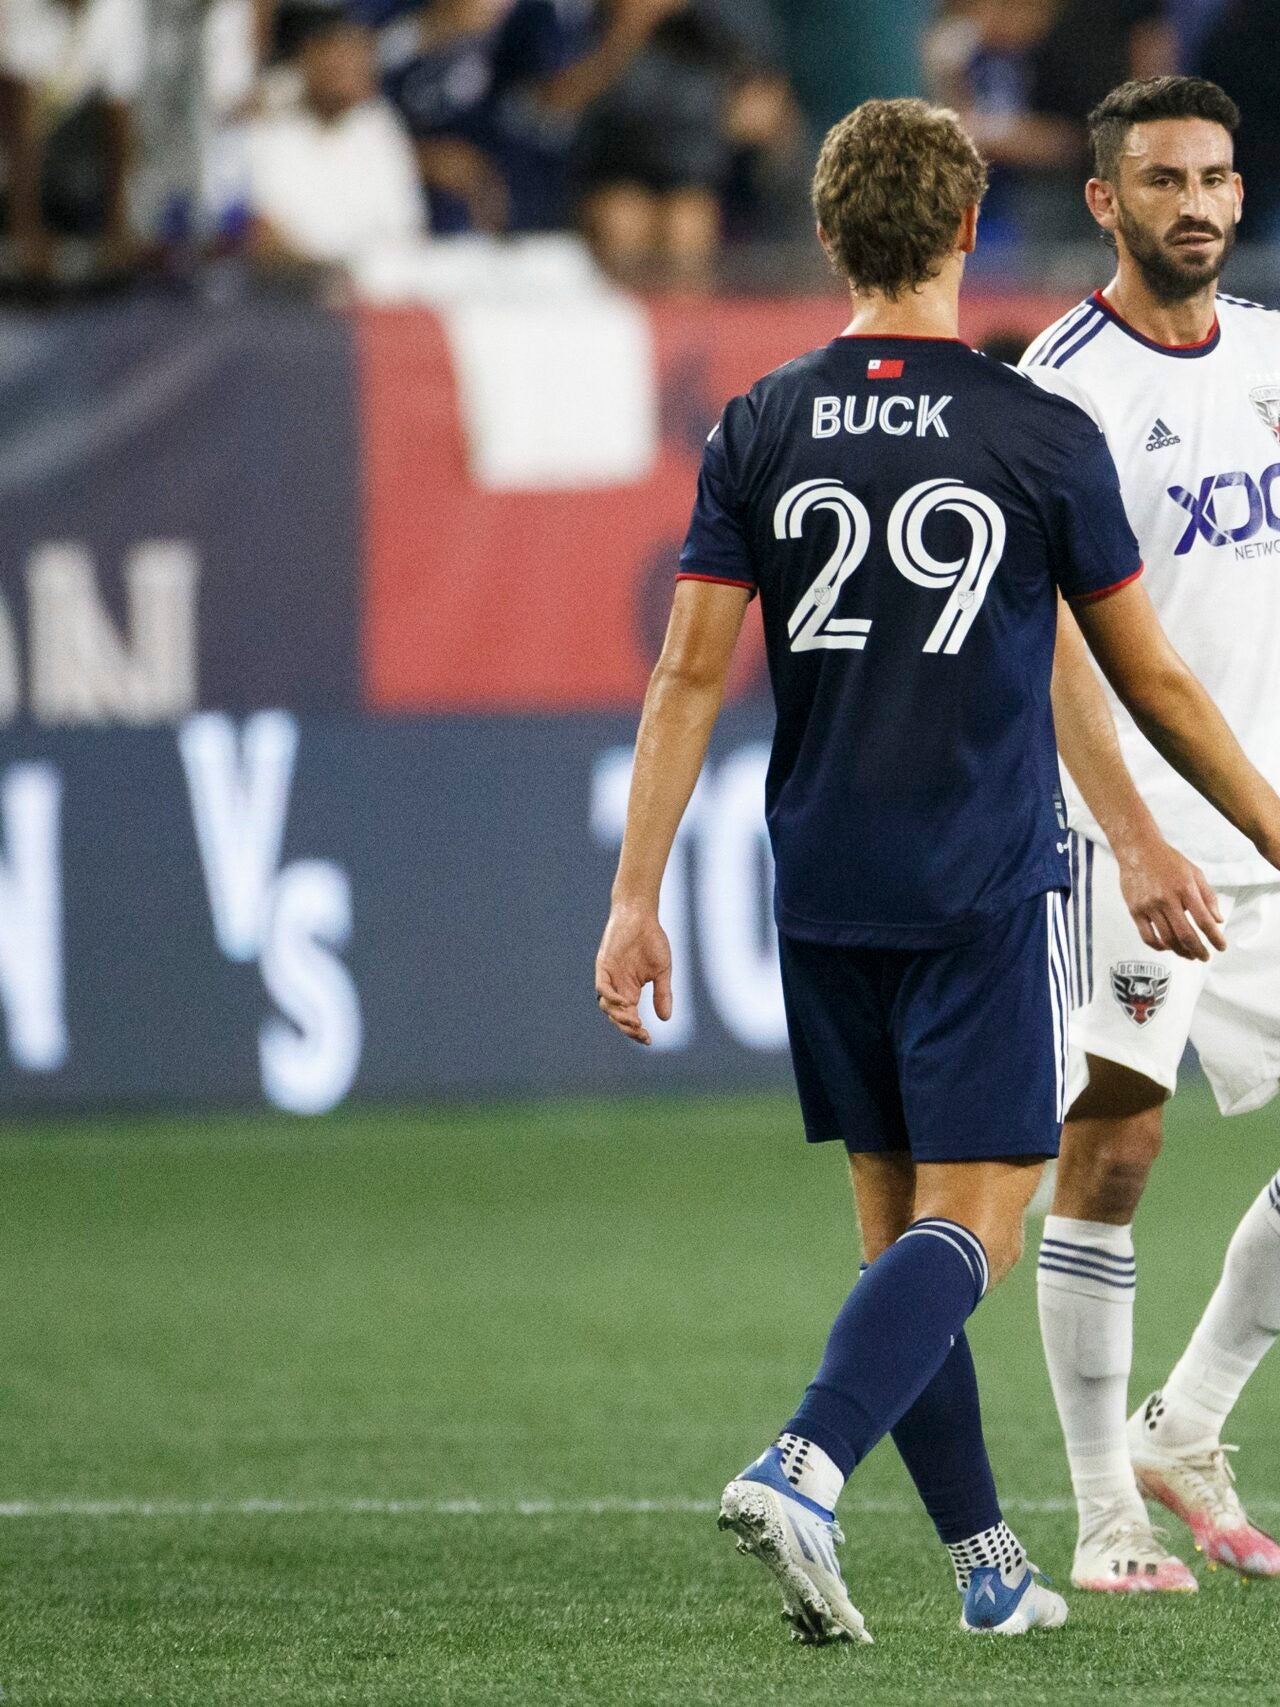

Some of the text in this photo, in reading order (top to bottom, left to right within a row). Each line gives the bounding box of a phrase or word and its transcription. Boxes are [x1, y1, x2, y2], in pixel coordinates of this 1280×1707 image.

[811, 394, 953, 440] BUCK
[1145, 435, 1181, 452] adidas
[772, 477, 1007, 655] 29
